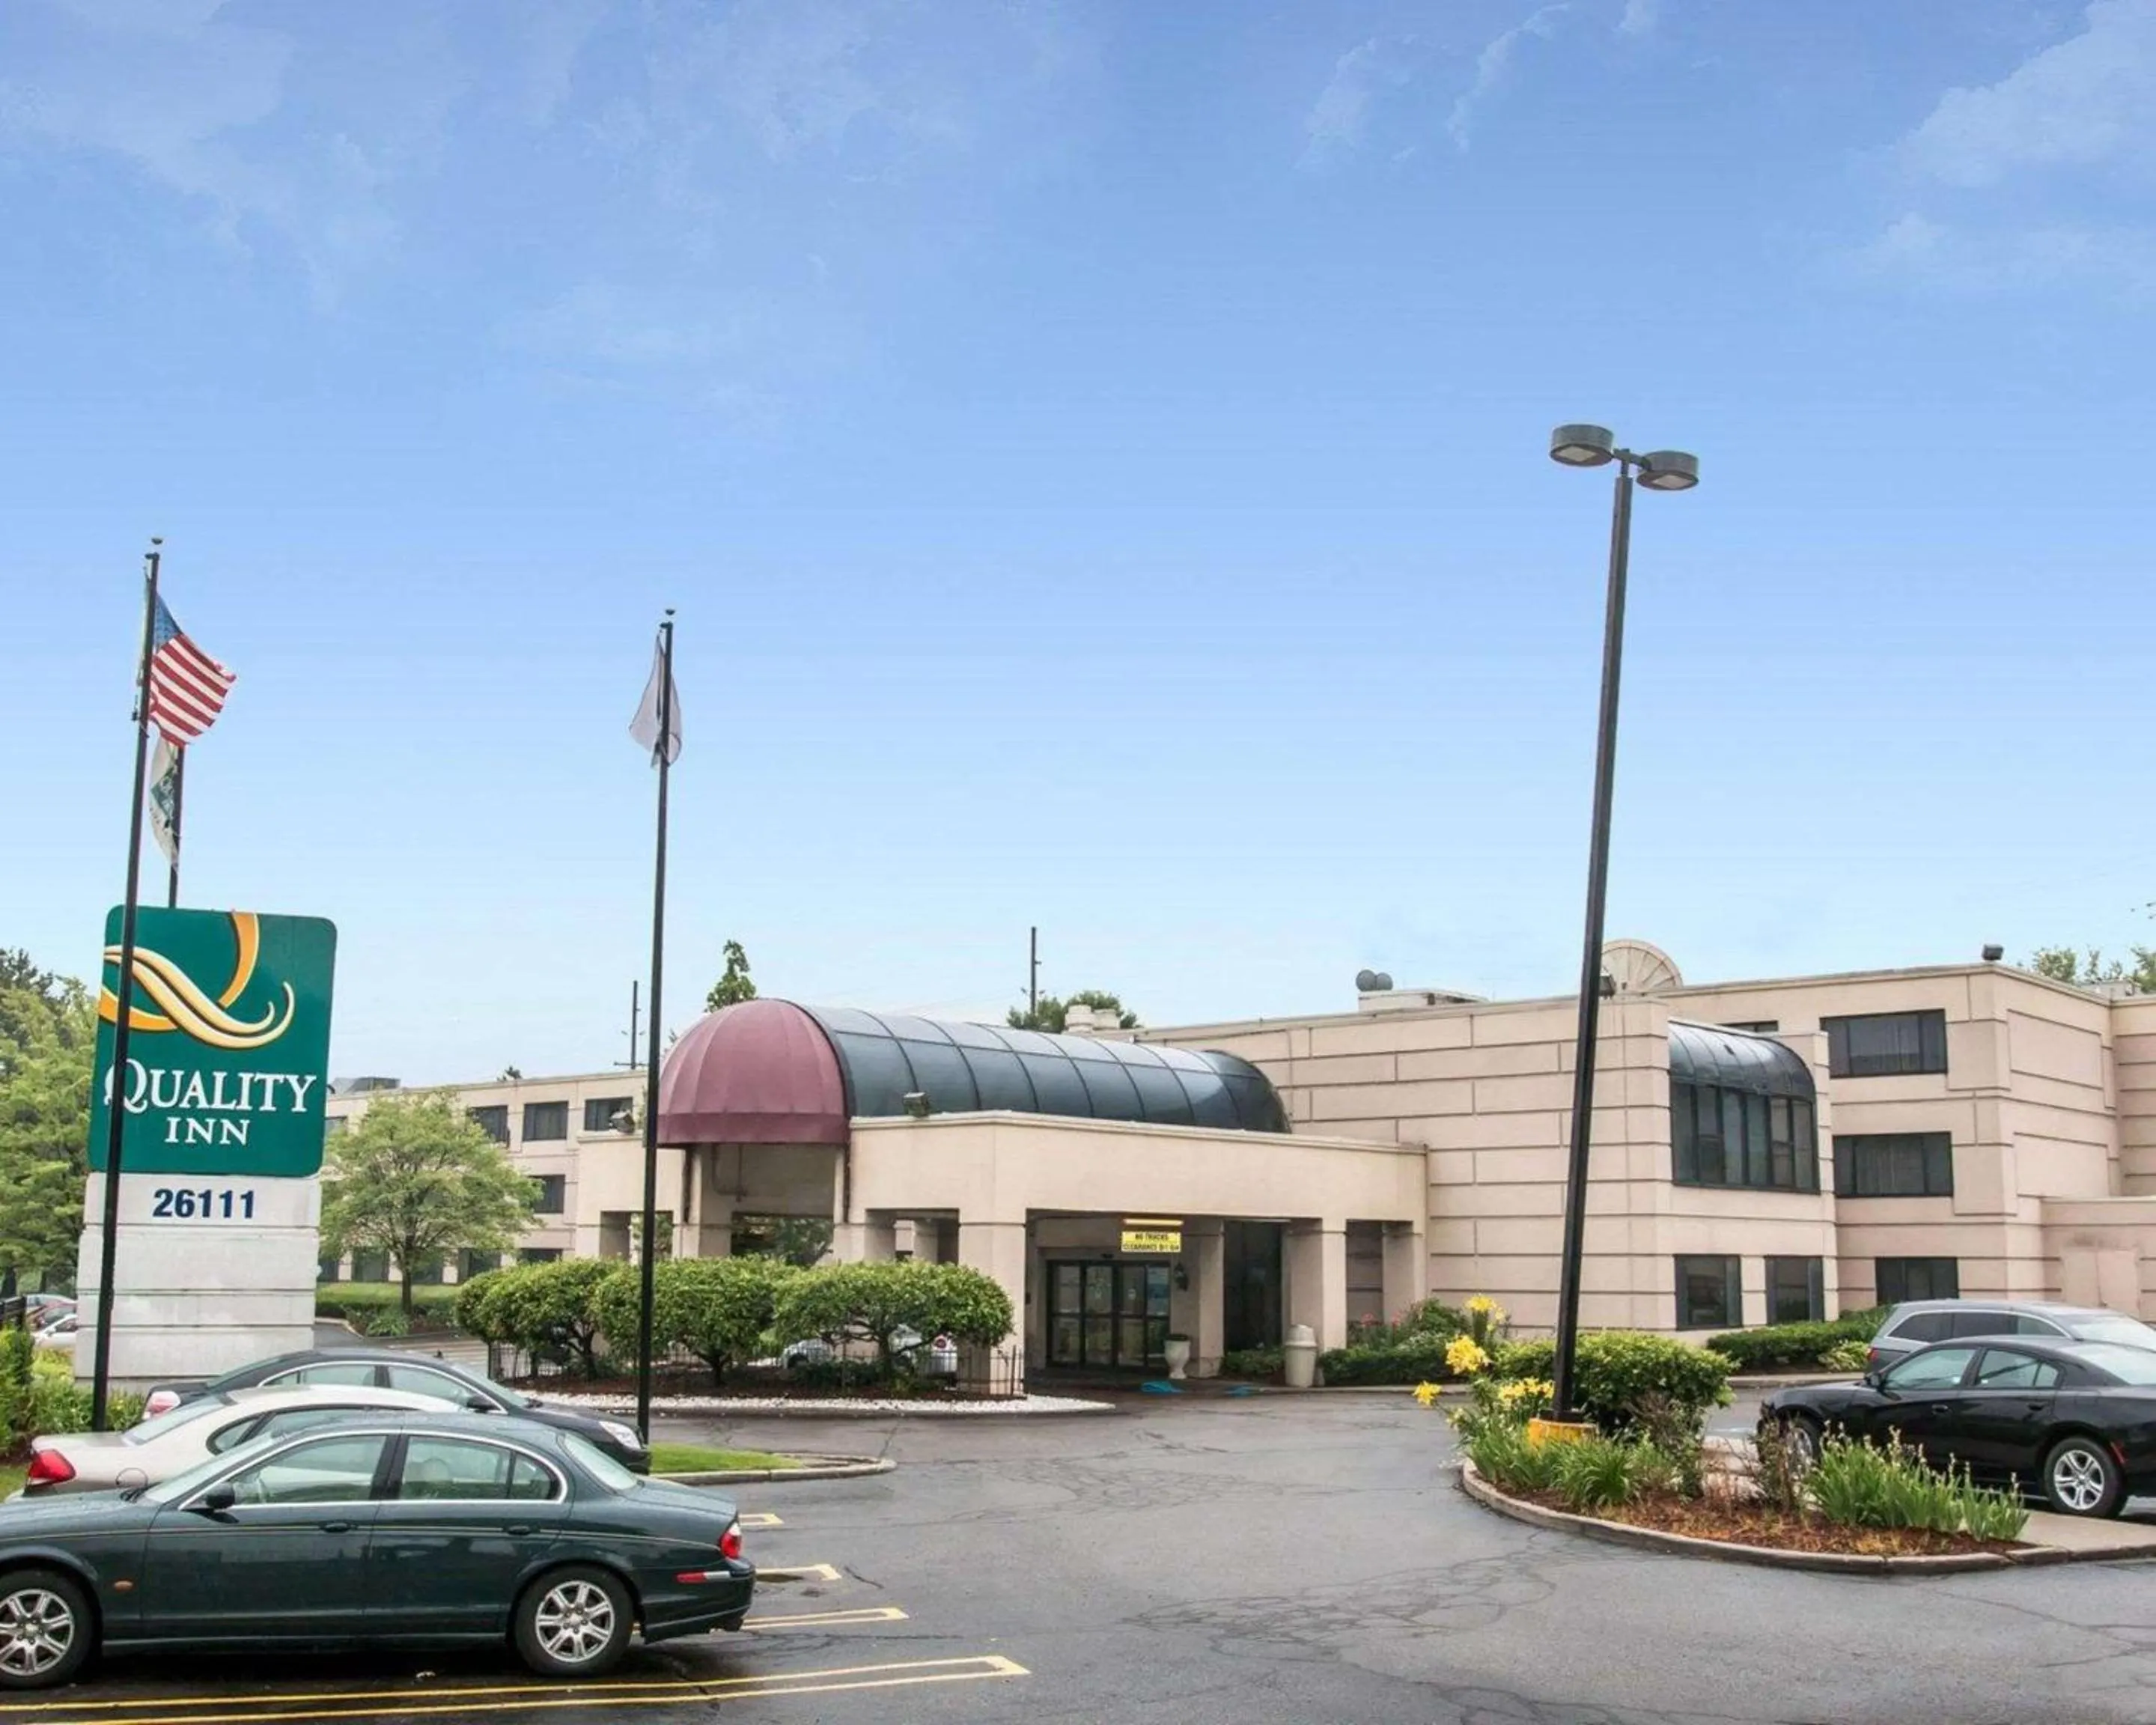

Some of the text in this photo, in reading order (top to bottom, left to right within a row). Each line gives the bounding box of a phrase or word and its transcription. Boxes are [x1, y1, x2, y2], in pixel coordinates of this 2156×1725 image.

[104, 1058, 317, 1114] QUALITY
[164, 1116, 250, 1146] INN
[152, 1188, 255, 1218] 26111
